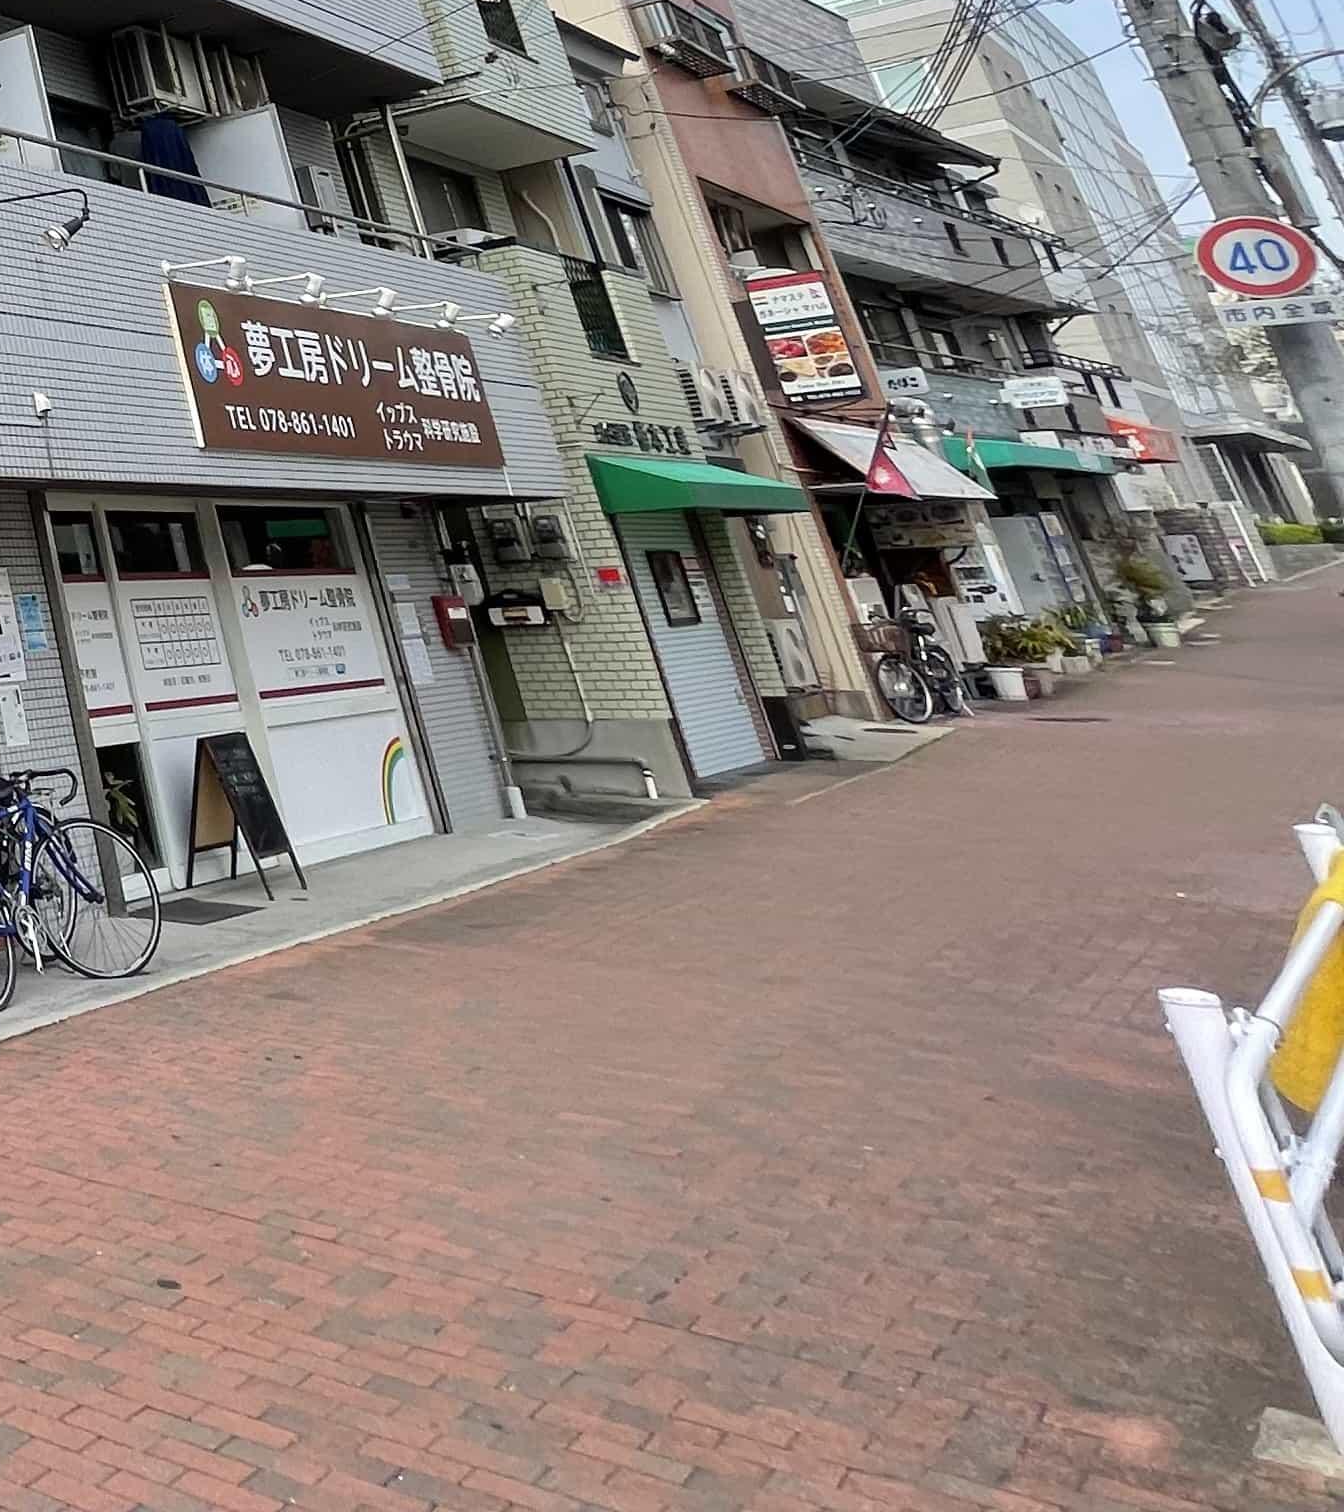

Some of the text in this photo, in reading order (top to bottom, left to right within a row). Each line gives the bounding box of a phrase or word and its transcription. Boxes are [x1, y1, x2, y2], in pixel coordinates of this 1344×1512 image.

[1230, 239, 1290, 274] 40
[240, 319, 482, 402] 夢工房ドリーム整骨院
[225, 404, 357, 438] TEL 078-861-1401
[383, 428, 425, 451] トラウマ
